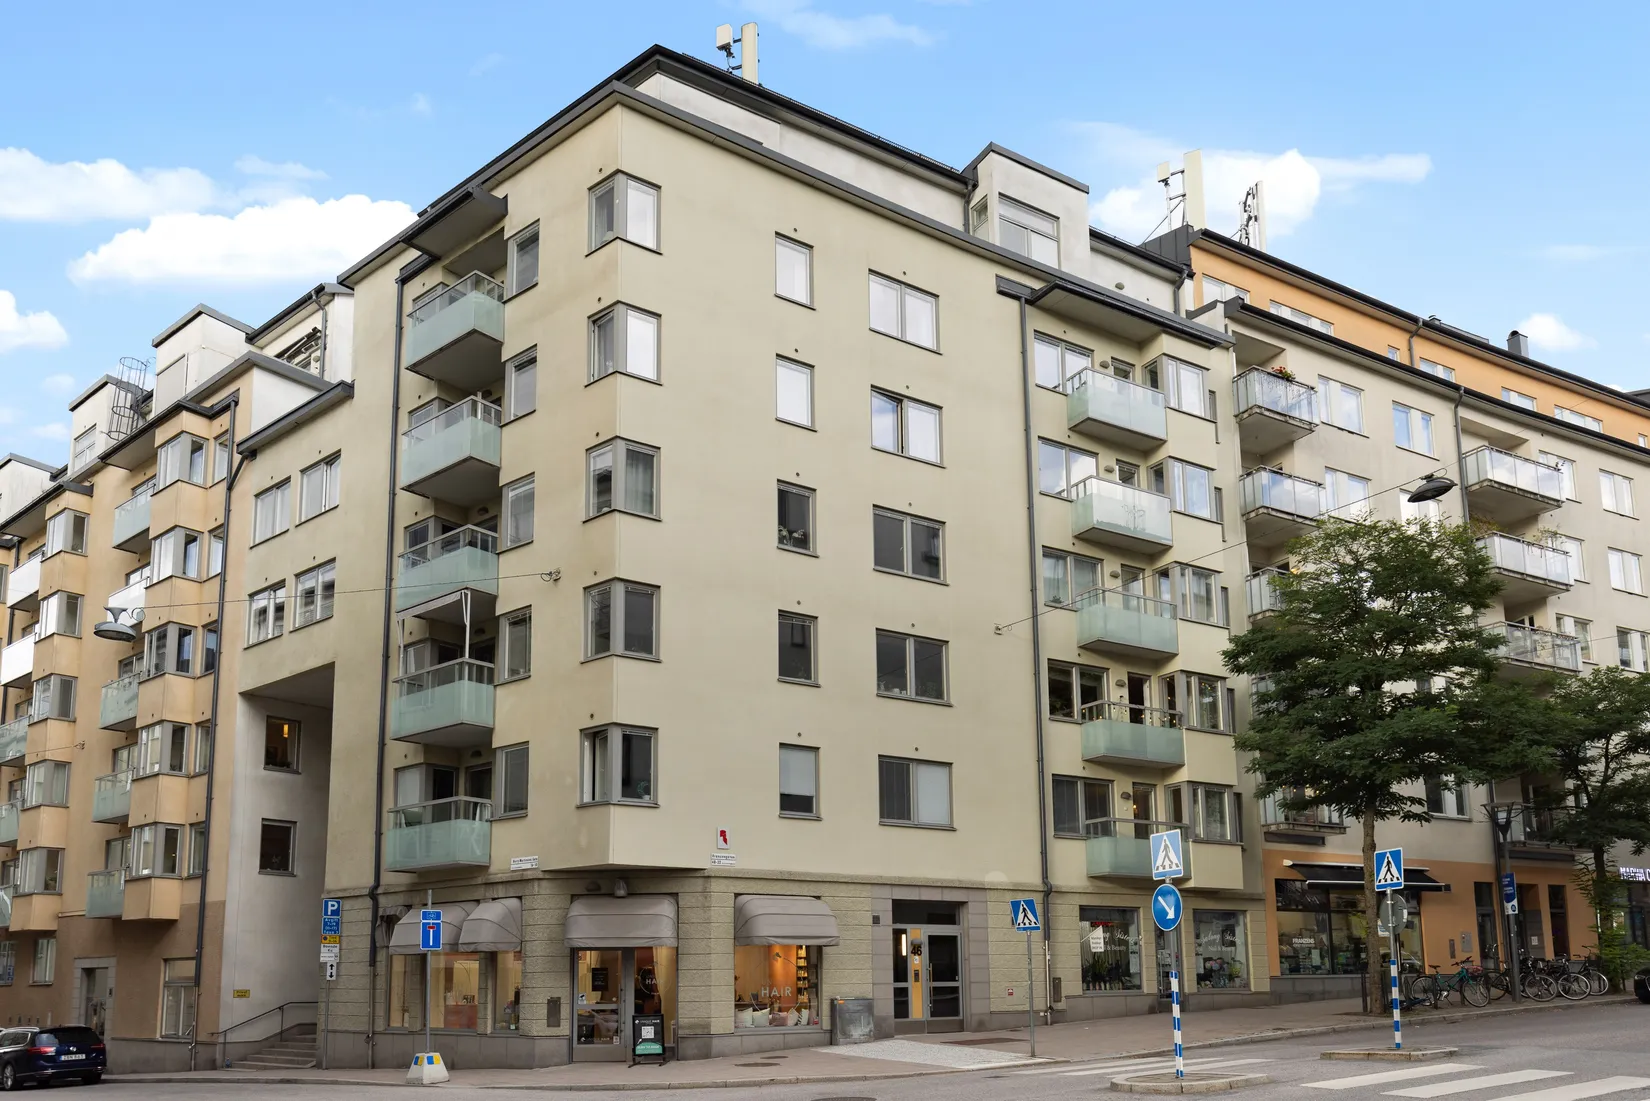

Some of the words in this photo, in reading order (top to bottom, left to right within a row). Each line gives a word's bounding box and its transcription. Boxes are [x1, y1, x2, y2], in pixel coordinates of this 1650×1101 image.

[327, 901, 338, 915] P
[911, 945, 922, 956] 46
[761, 986, 792, 997] HAIR
